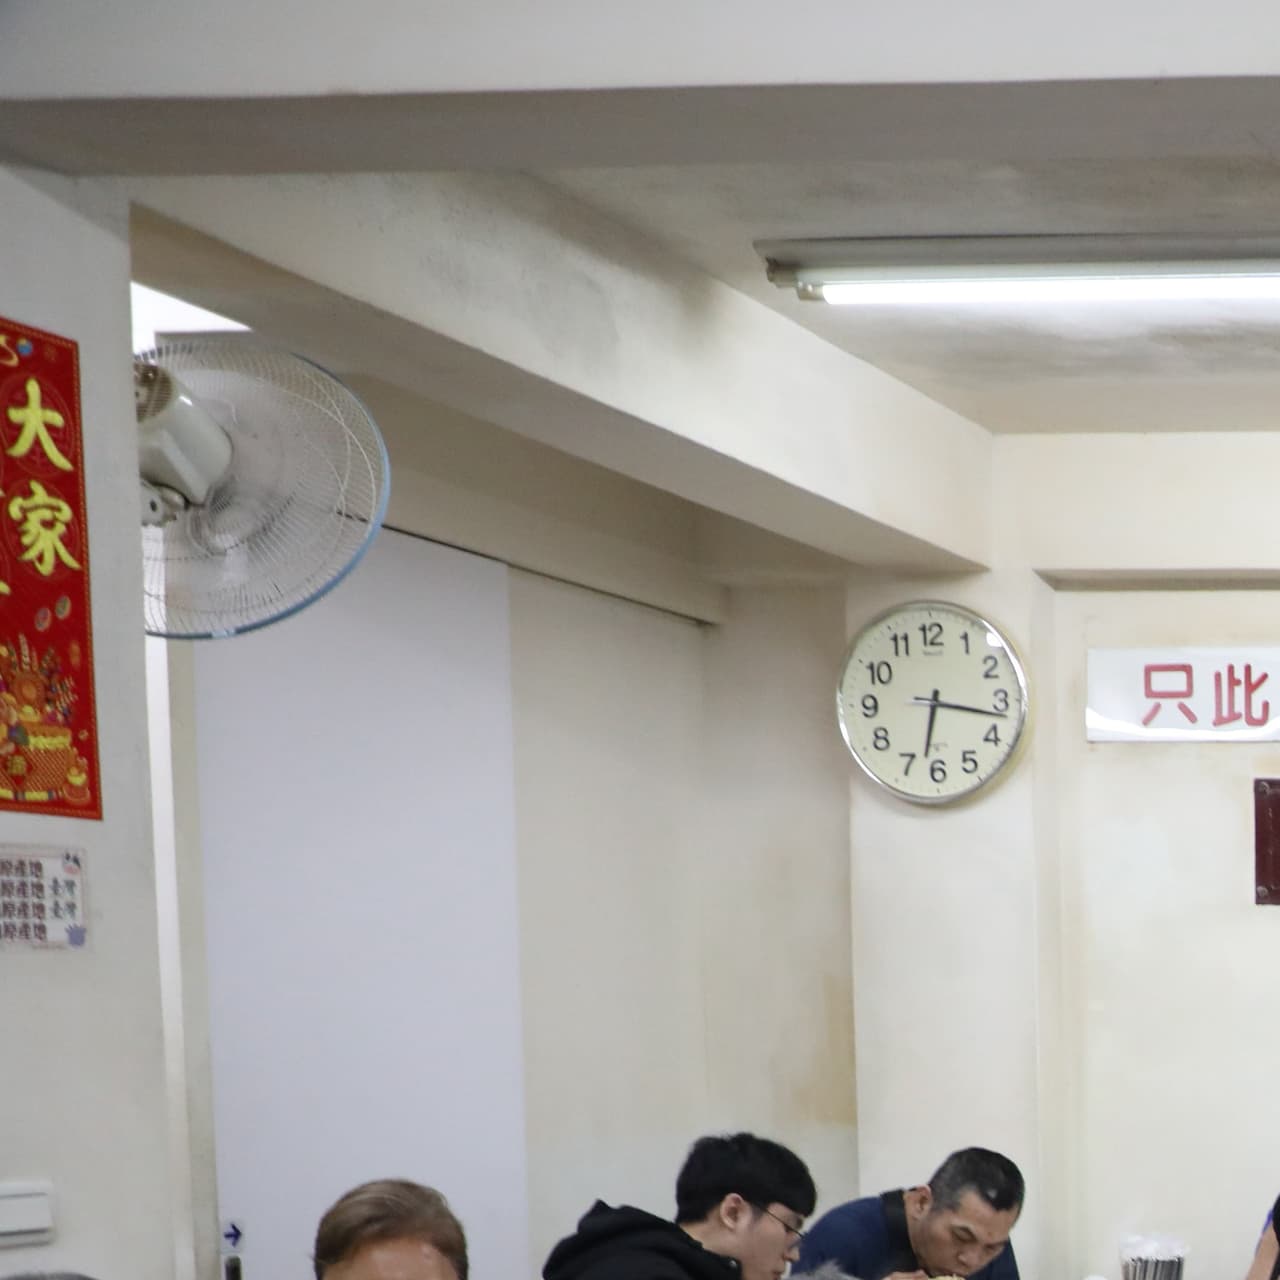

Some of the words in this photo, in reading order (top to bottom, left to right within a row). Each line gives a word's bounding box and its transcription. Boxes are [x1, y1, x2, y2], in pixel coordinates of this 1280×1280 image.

[891, 633, 910, 657] 11
[918, 622, 945, 648] 12
[960, 631, 970, 655] 1
[866, 660, 893, 686] 10
[982, 657, 999, 678] 2
[861, 694, 878, 719] 9
[993, 688, 1009, 713] 3
[873, 727, 890, 751] 8
[983, 724, 1001, 747] 4
[900, 753, 916, 776] 7
[930, 759, 947, 783] 6
[962, 751, 978, 774] 5
